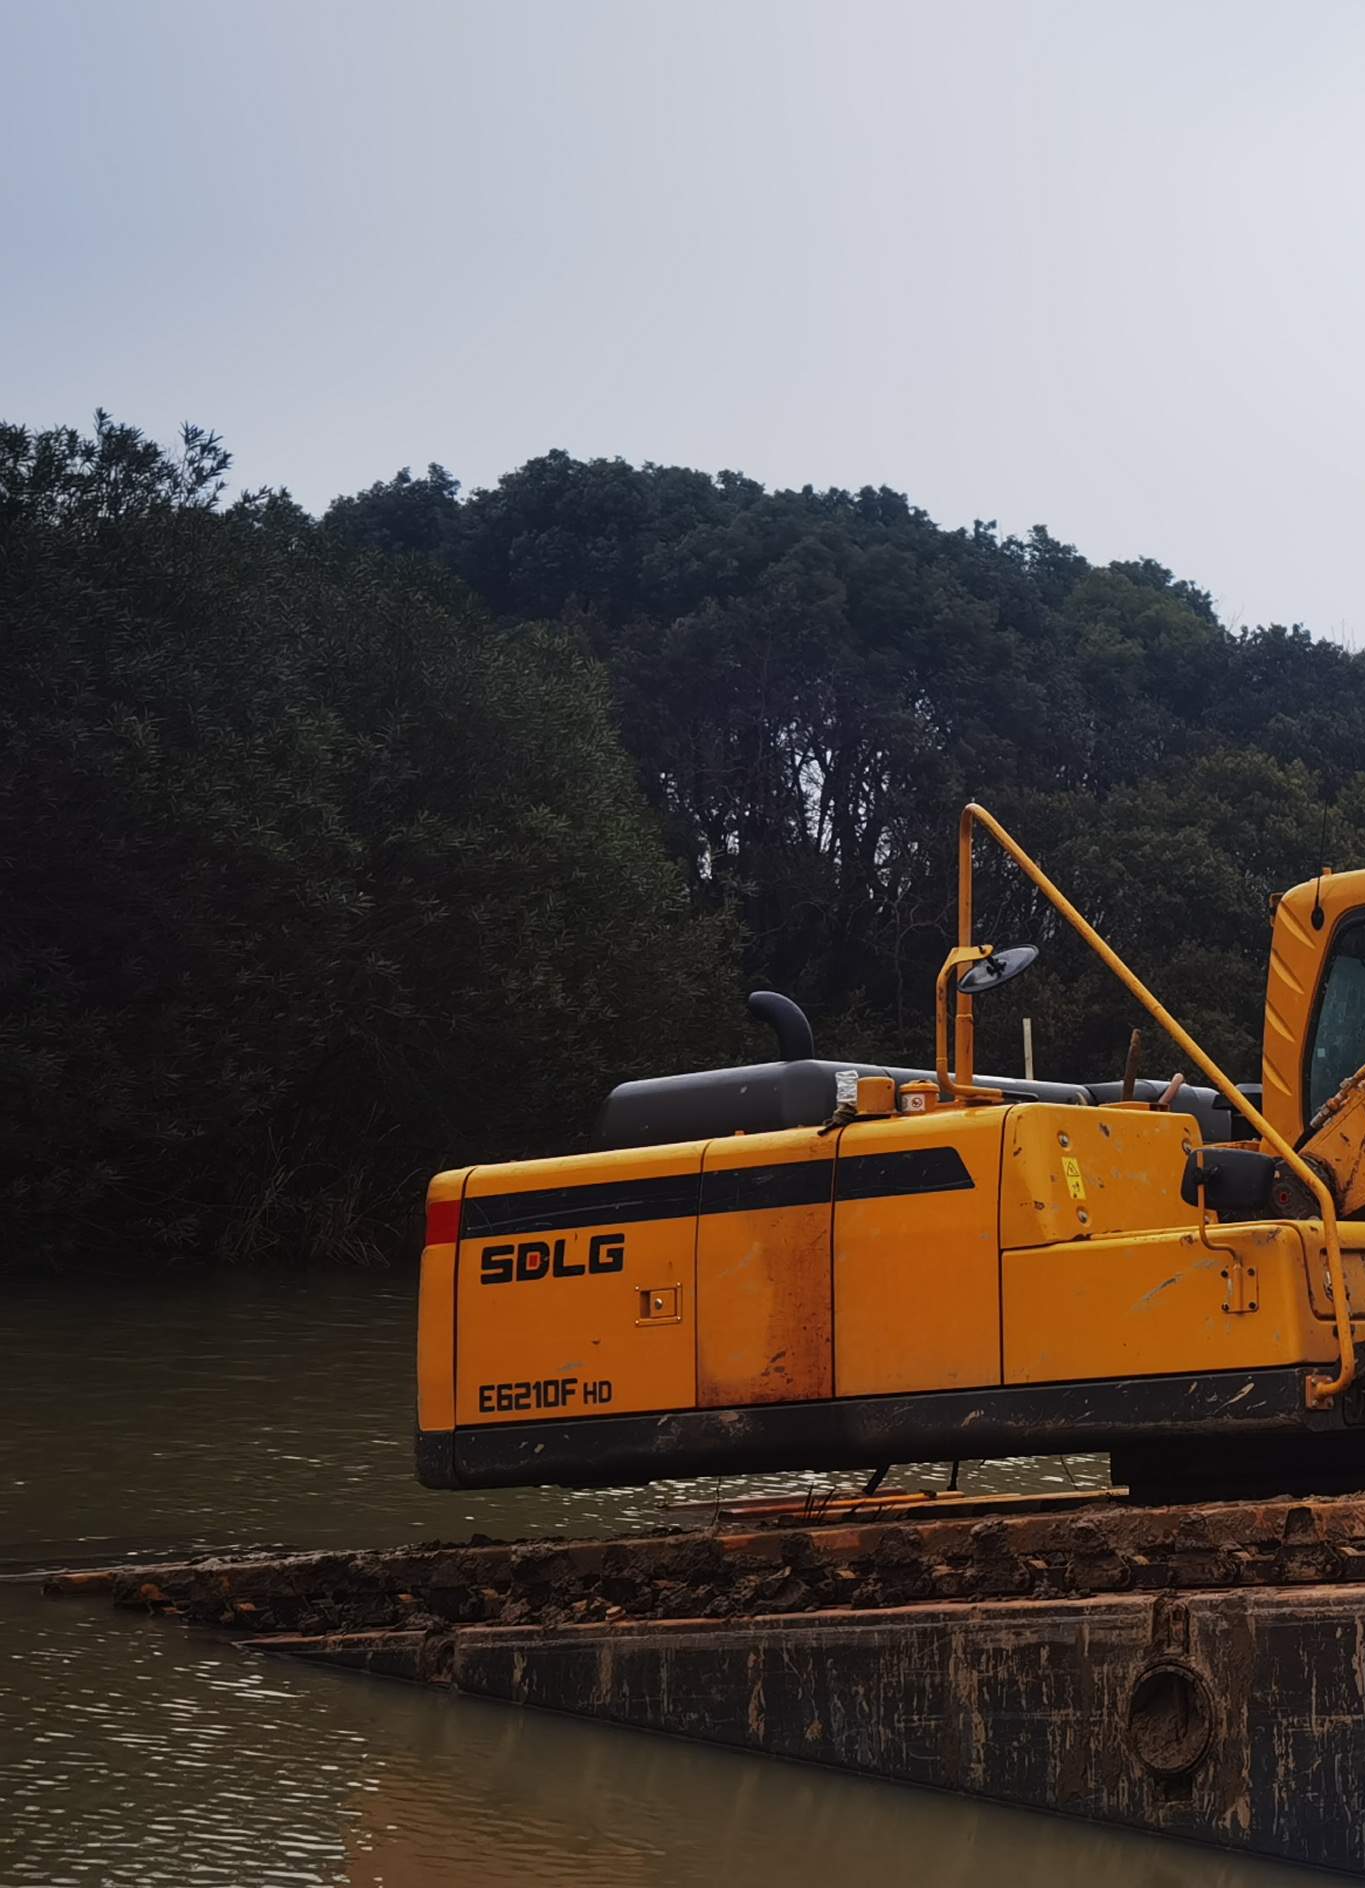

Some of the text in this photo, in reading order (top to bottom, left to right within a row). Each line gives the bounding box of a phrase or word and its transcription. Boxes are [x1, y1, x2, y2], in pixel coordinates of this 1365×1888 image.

[480, 1232, 626, 1286] SDLG
[479, 1377, 613, 1413] E6210F HD
